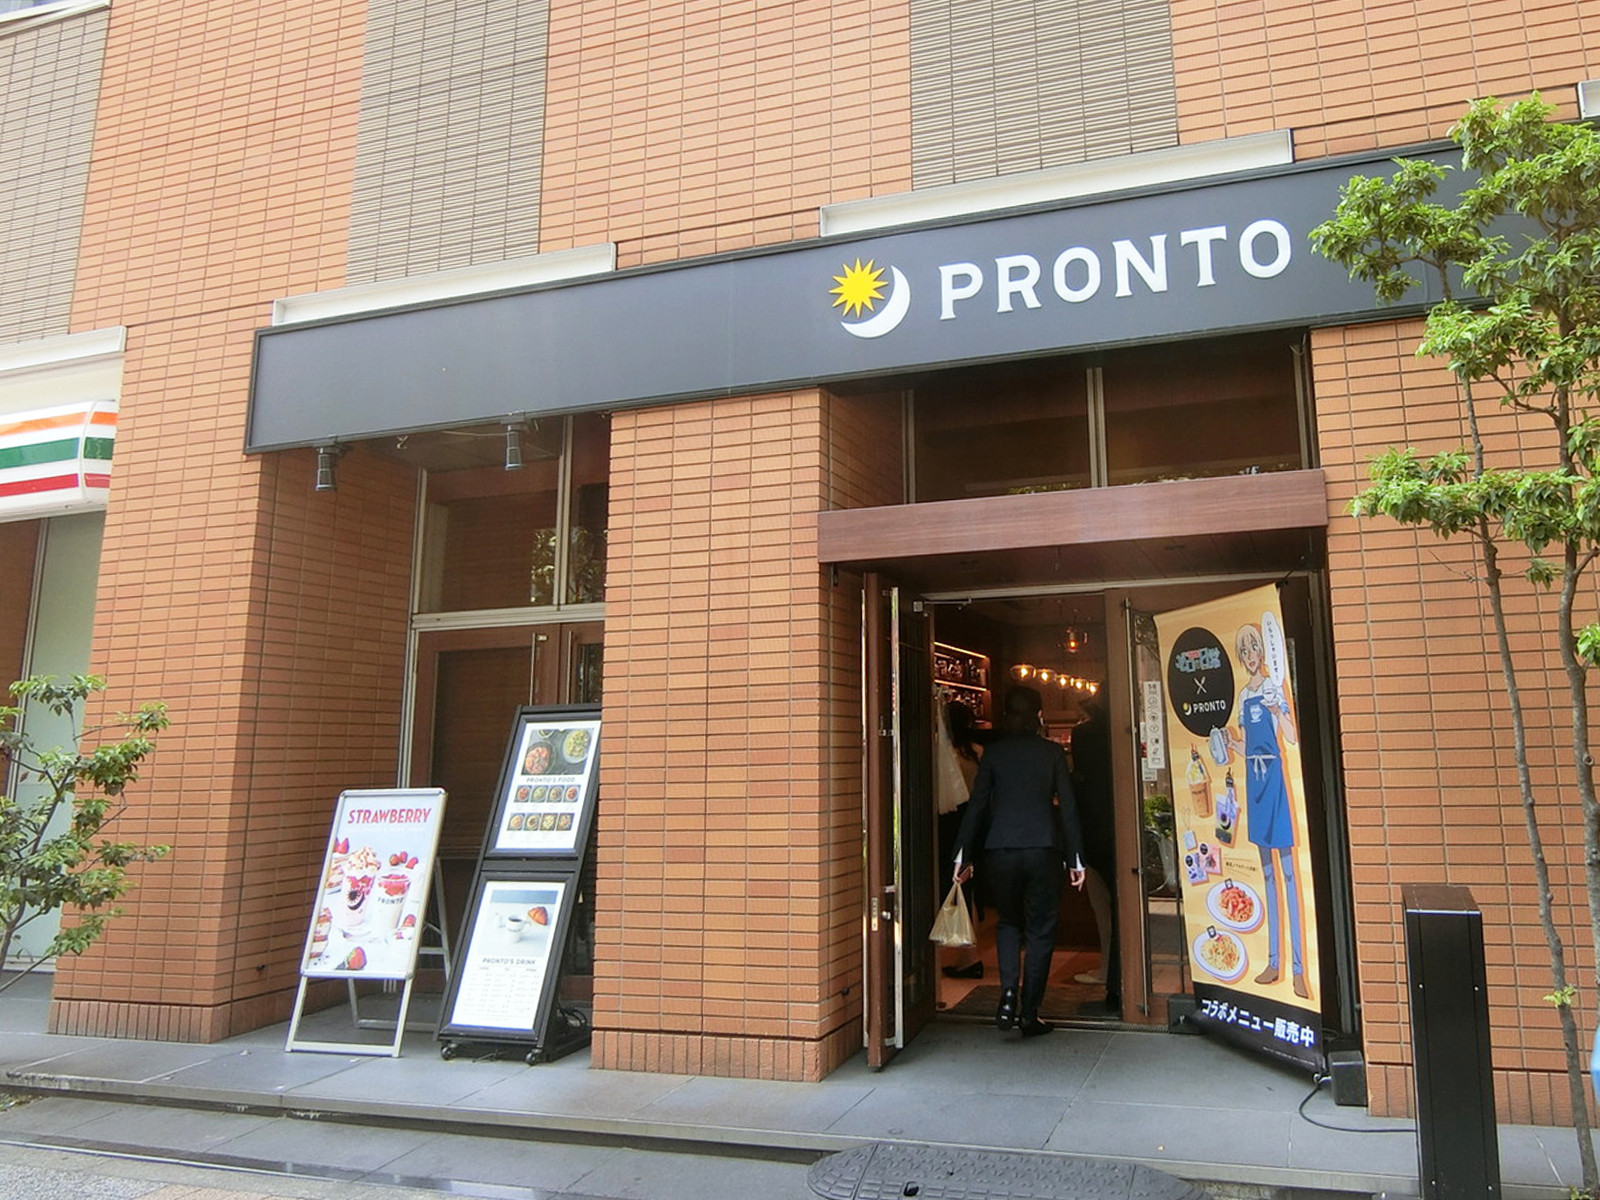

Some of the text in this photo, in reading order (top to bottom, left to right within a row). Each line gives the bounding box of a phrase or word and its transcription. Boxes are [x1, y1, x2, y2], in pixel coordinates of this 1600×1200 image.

[938, 219, 1292, 320] PRONTO
[1193, 700, 1226, 713] PRONTO
[347, 807, 432, 824] STRAWBERRY
